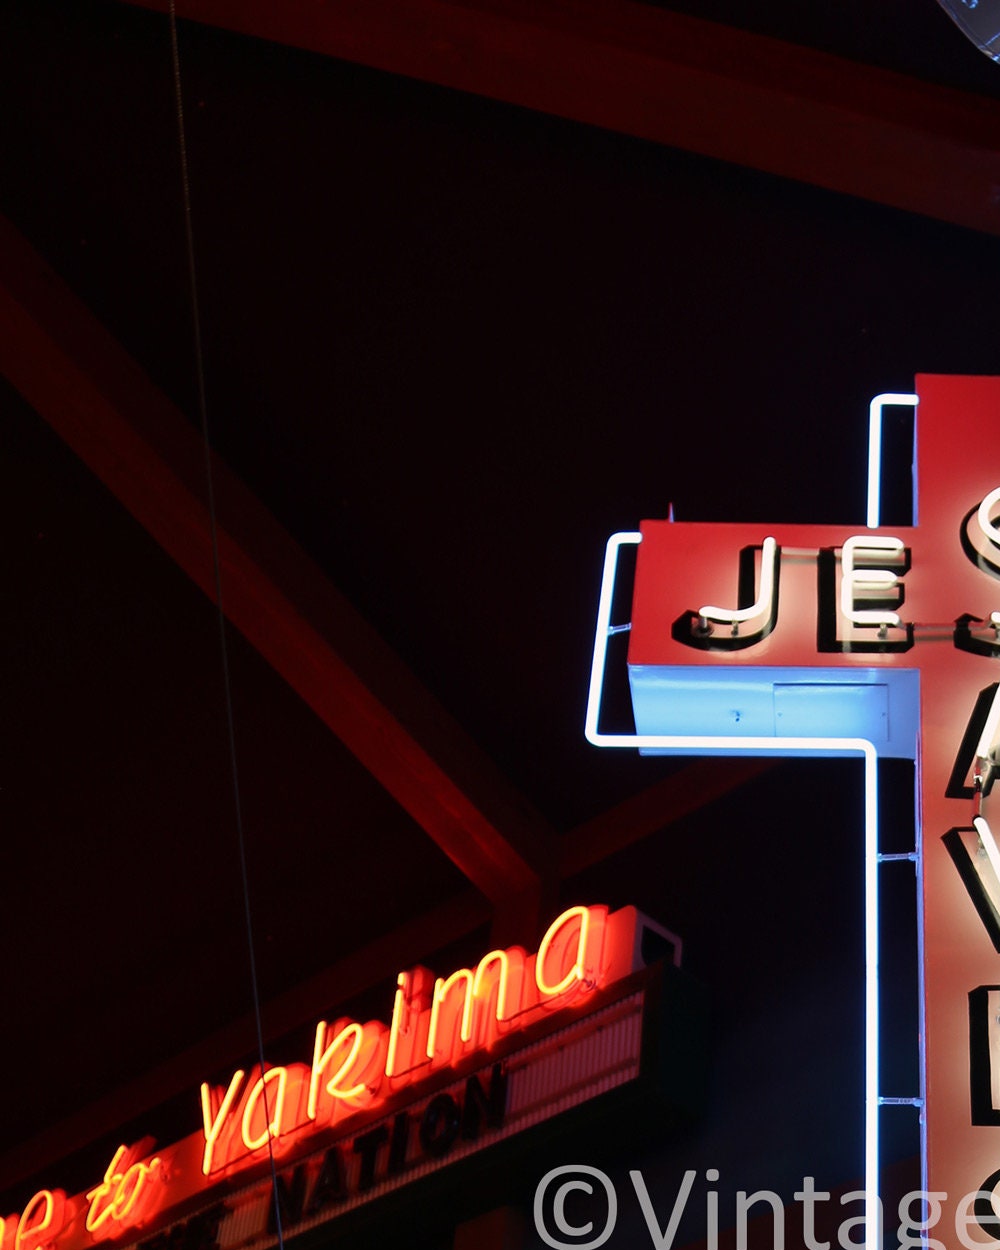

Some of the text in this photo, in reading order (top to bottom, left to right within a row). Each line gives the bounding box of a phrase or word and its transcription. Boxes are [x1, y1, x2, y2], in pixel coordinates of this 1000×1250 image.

[85, 1143, 163, 1233] to
[200, 904, 606, 1178] Yakima
[268, 1060, 507, 1236] NATION
